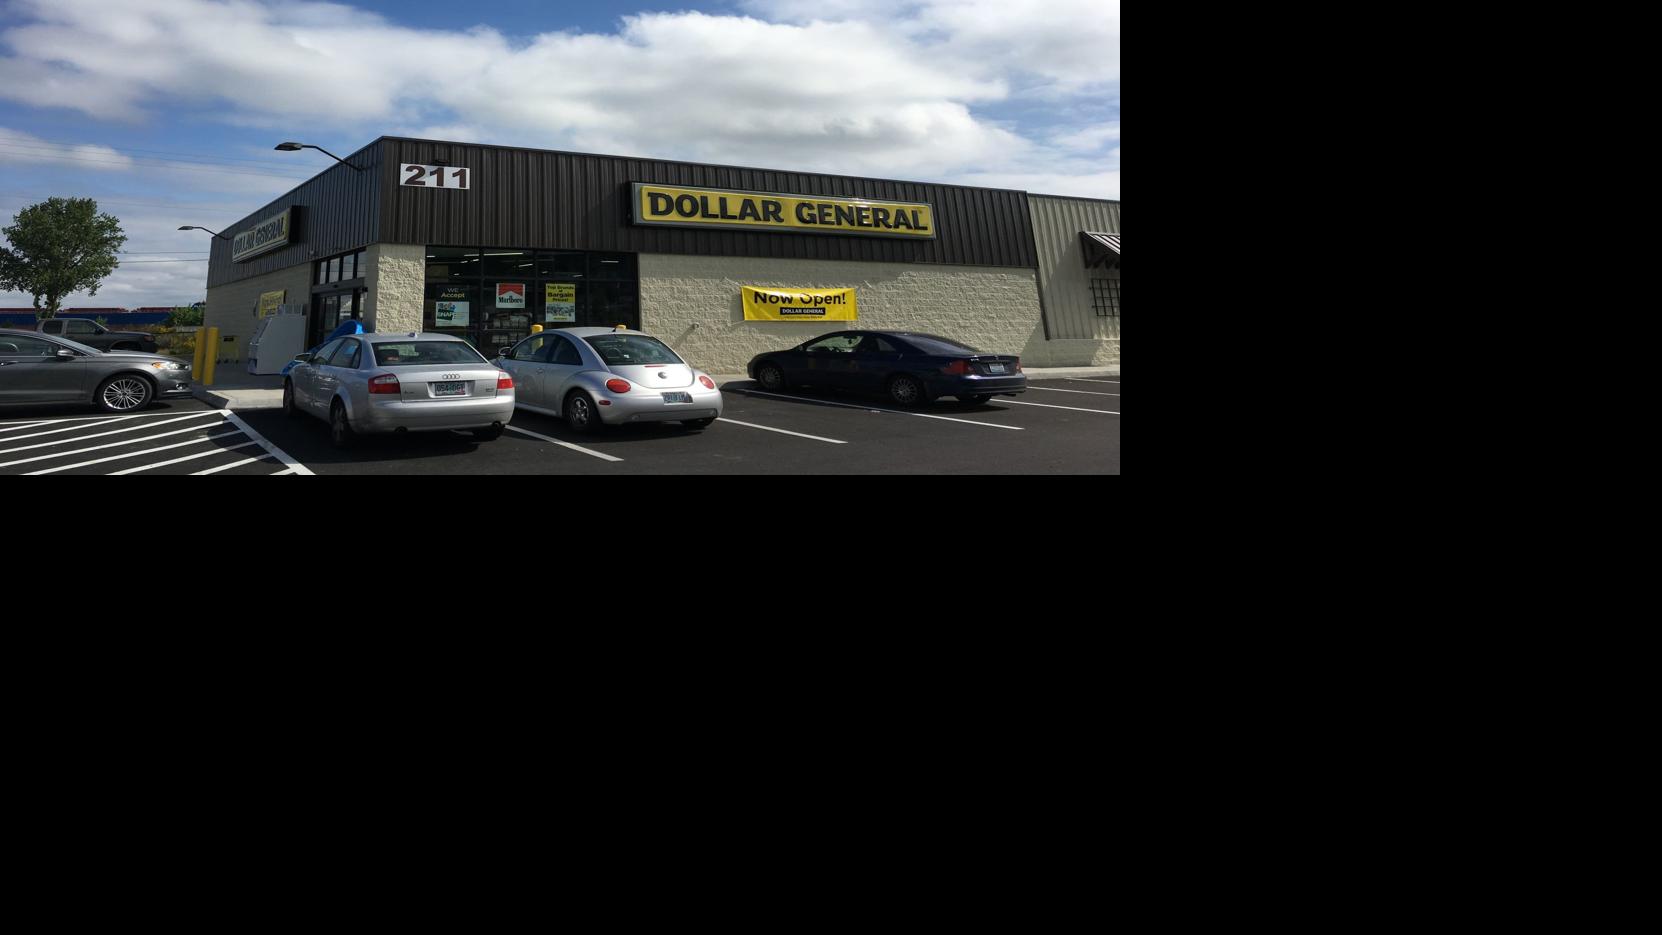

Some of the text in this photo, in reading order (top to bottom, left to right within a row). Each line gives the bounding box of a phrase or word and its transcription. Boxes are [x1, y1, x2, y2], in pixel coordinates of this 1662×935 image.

[405, 165, 467, 188] 211
[648, 192, 928, 231] DOLLAR GENERAL
[233, 215, 286, 256] DOLLAR GENERAL
[498, 295, 523, 303] Marlboro
[754, 291, 847, 306] Now Open!
